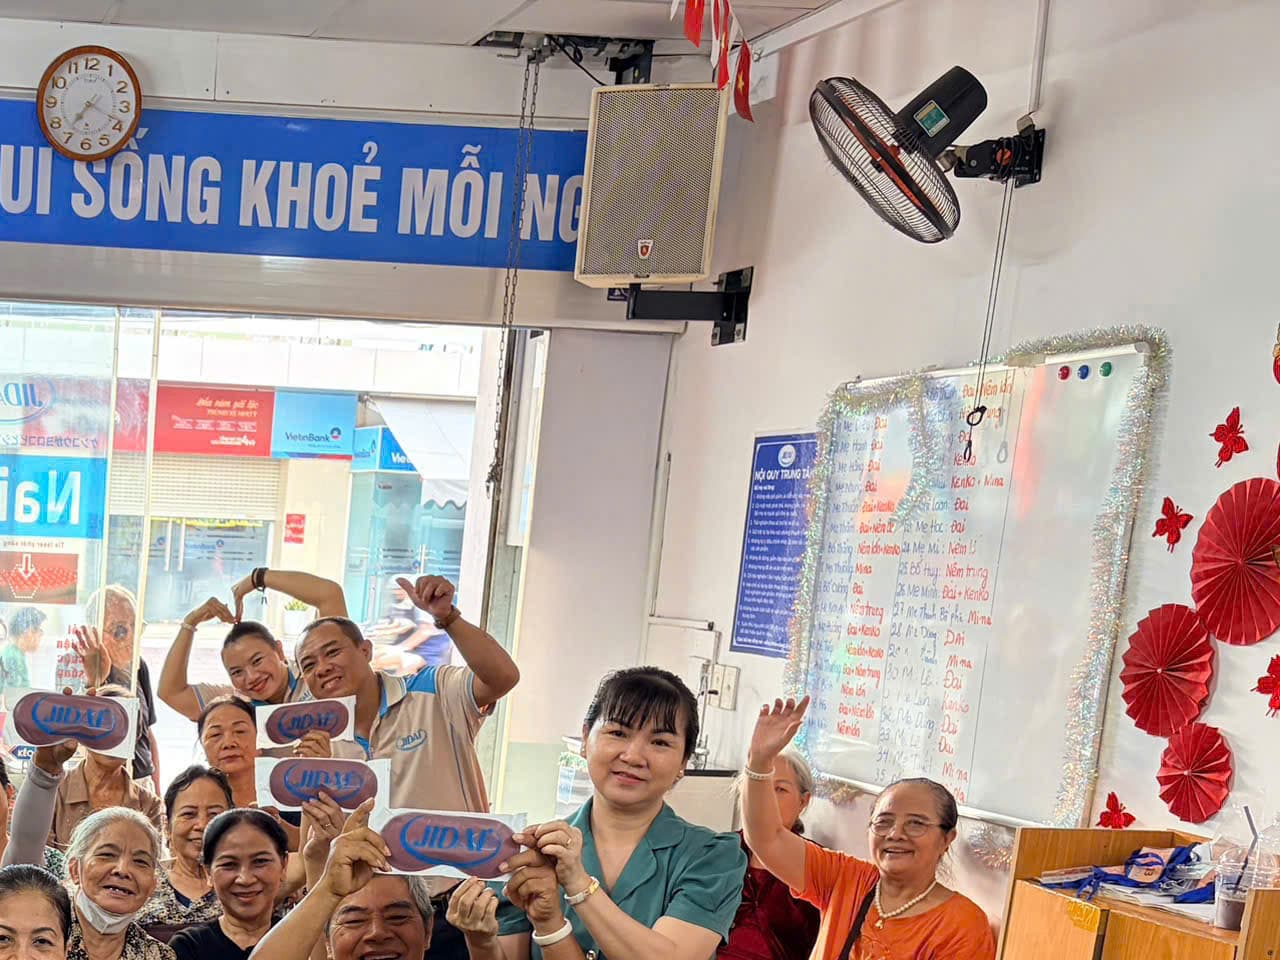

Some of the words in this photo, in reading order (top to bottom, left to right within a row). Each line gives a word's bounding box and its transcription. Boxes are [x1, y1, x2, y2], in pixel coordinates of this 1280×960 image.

[68, 61, 78, 74] 11
[84, 57, 100, 70] 12
[107, 64, 113, 77] 1
[51, 76, 66, 89] 10
[116, 81, 128, 93] 2
[46, 95, 57, 108] 9
[118, 100, 130, 113] 3
[50, 117, 62, 129] 8
[112, 120, 123, 132] 4
[63, 132, 74, 144] 7
[80, 138, 92, 151] 6
[99, 134, 110, 146] 5
[71, 128, 222, 226] SỐNG
[239, 141, 382, 234] KHOẺ
[396, 144, 503, 239] MỖI
[285, 431, 330, 443] VietinBank
